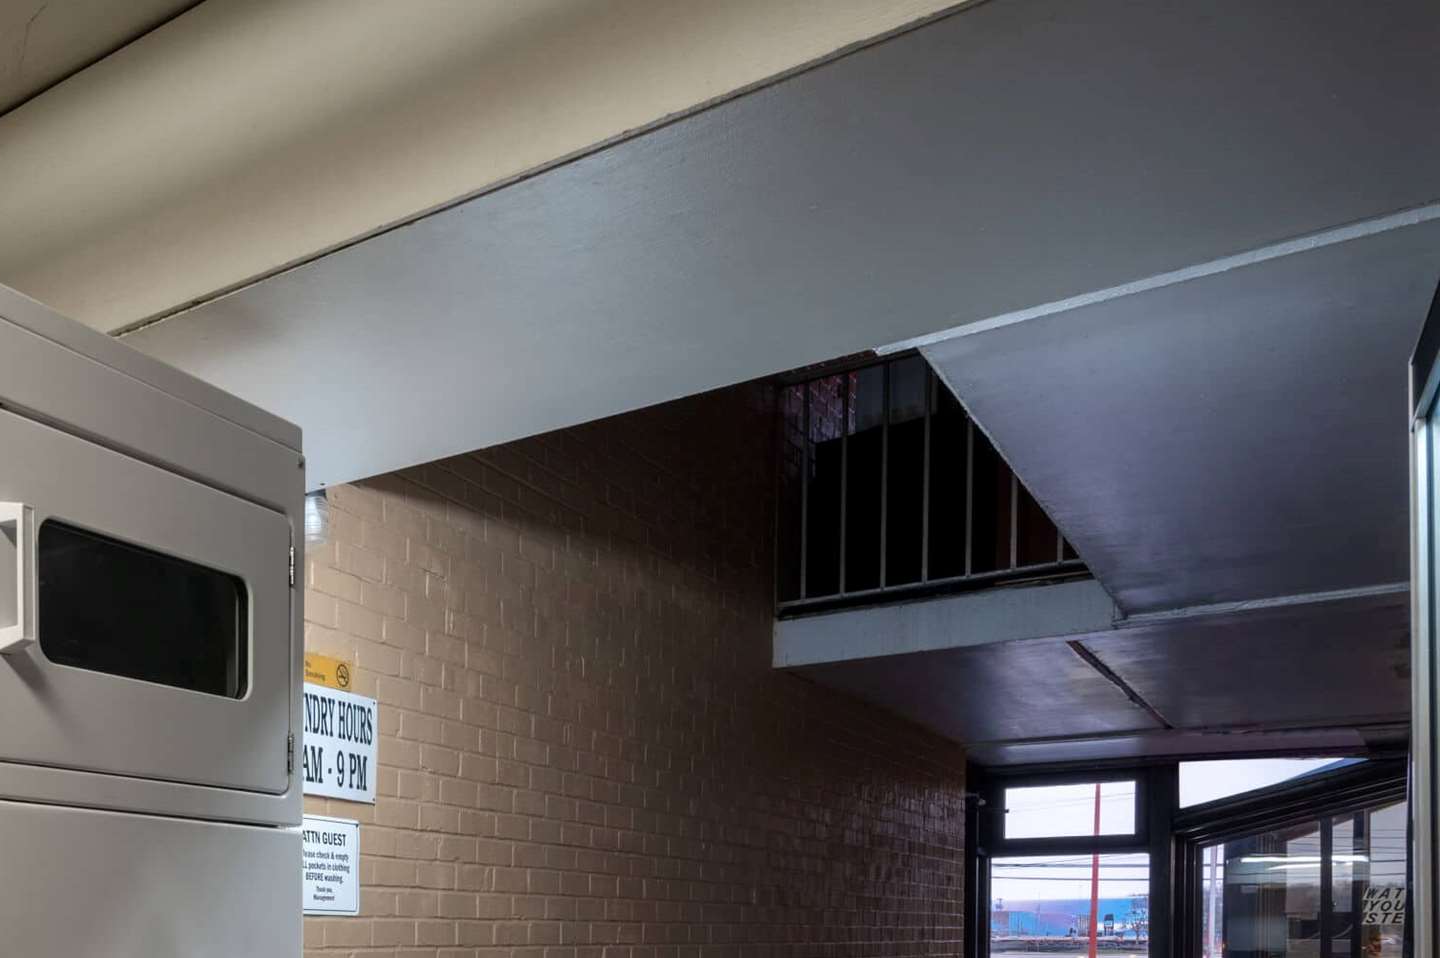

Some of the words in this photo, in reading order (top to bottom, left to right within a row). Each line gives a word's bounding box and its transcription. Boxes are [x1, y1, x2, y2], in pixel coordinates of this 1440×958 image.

[304, 692, 335, 737] NDRY
[338, 700, 373, 746] HOURS
[337, 750, 345, 787] 9
[349, 753, 367, 791] PM
[322, 832, 346, 847] GUEST
[1366, 888, 1405, 899] WAT
[1369, 900, 1405, 912] YOU
[1366, 912, 1404, 924] STE
